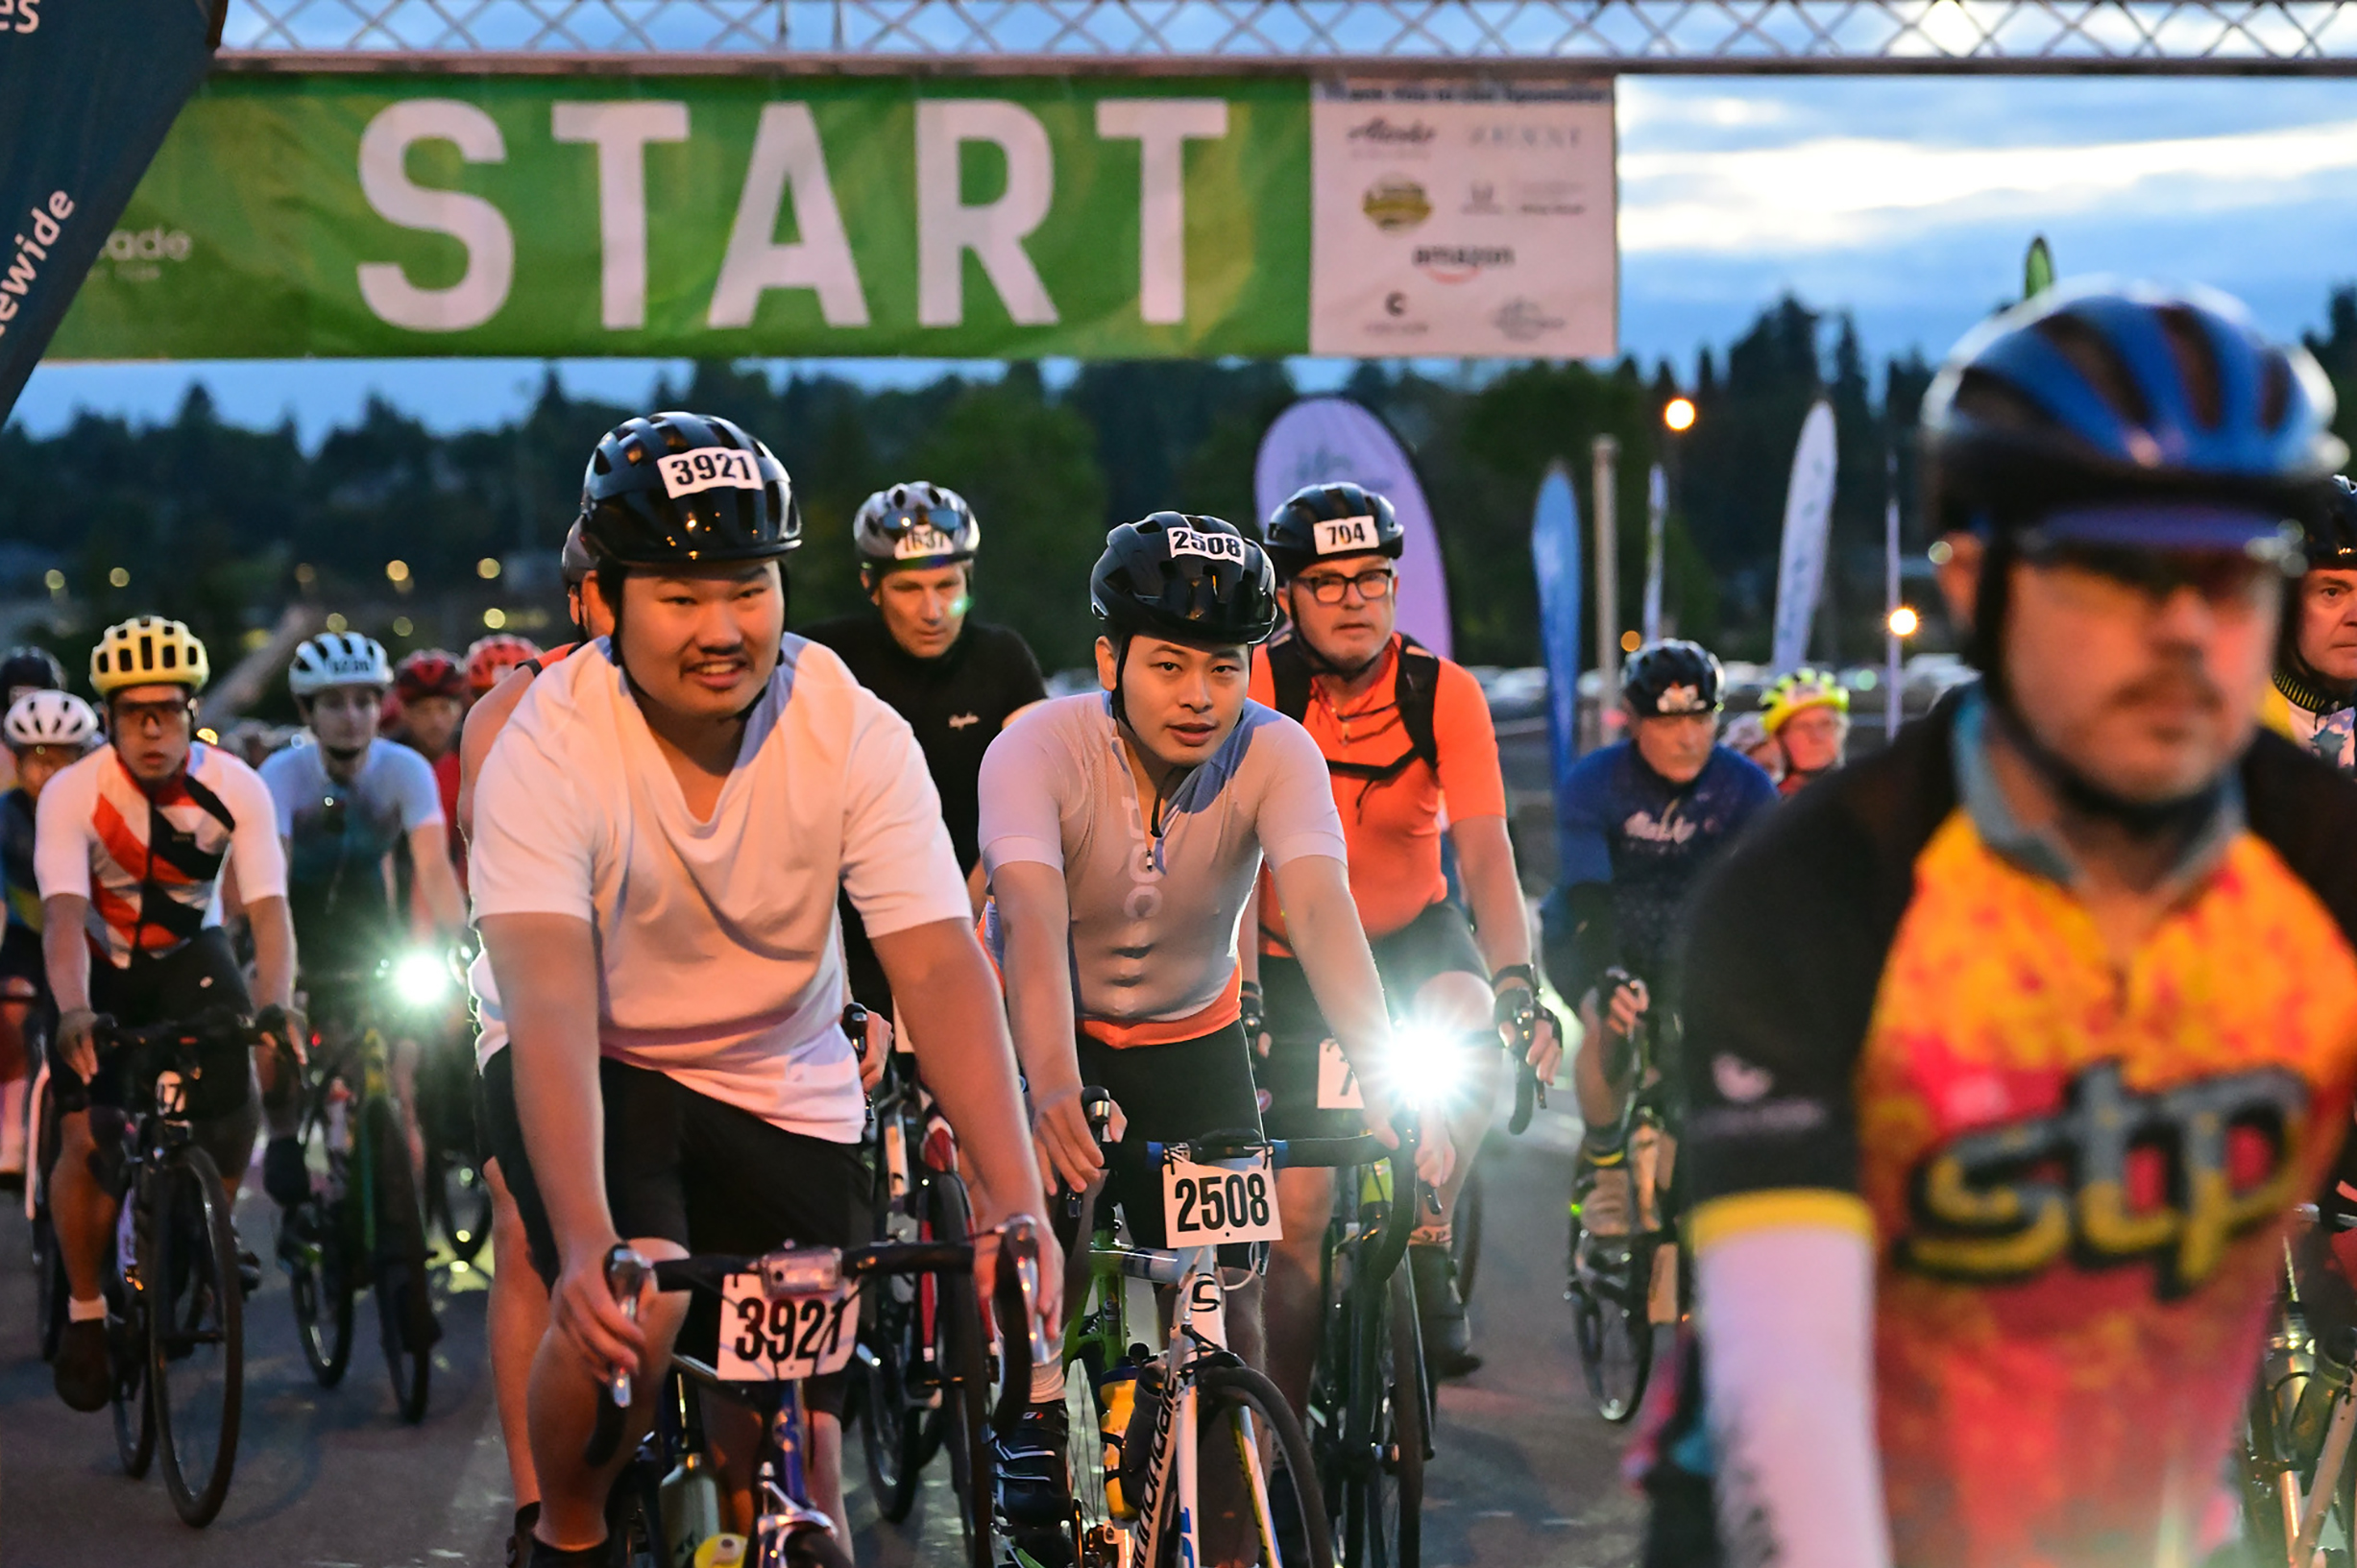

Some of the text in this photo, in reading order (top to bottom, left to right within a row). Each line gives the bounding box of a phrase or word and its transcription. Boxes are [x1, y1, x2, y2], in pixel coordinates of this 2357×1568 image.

[356, 98, 1229, 332] START
[0, 190, 75, 336] ewide
[99, 227, 191, 261] ade
[1412, 246, 1515, 268] amazon
[670, 453, 752, 486] 3921
[1173, 529, 1242, 559] 2508
[1325, 521, 1367, 546] 704
[1175, 1172, 1269, 1233] 2508
[735, 1297, 845, 1363] 3921
[1134, 1369, 1177, 1568] nnondale
